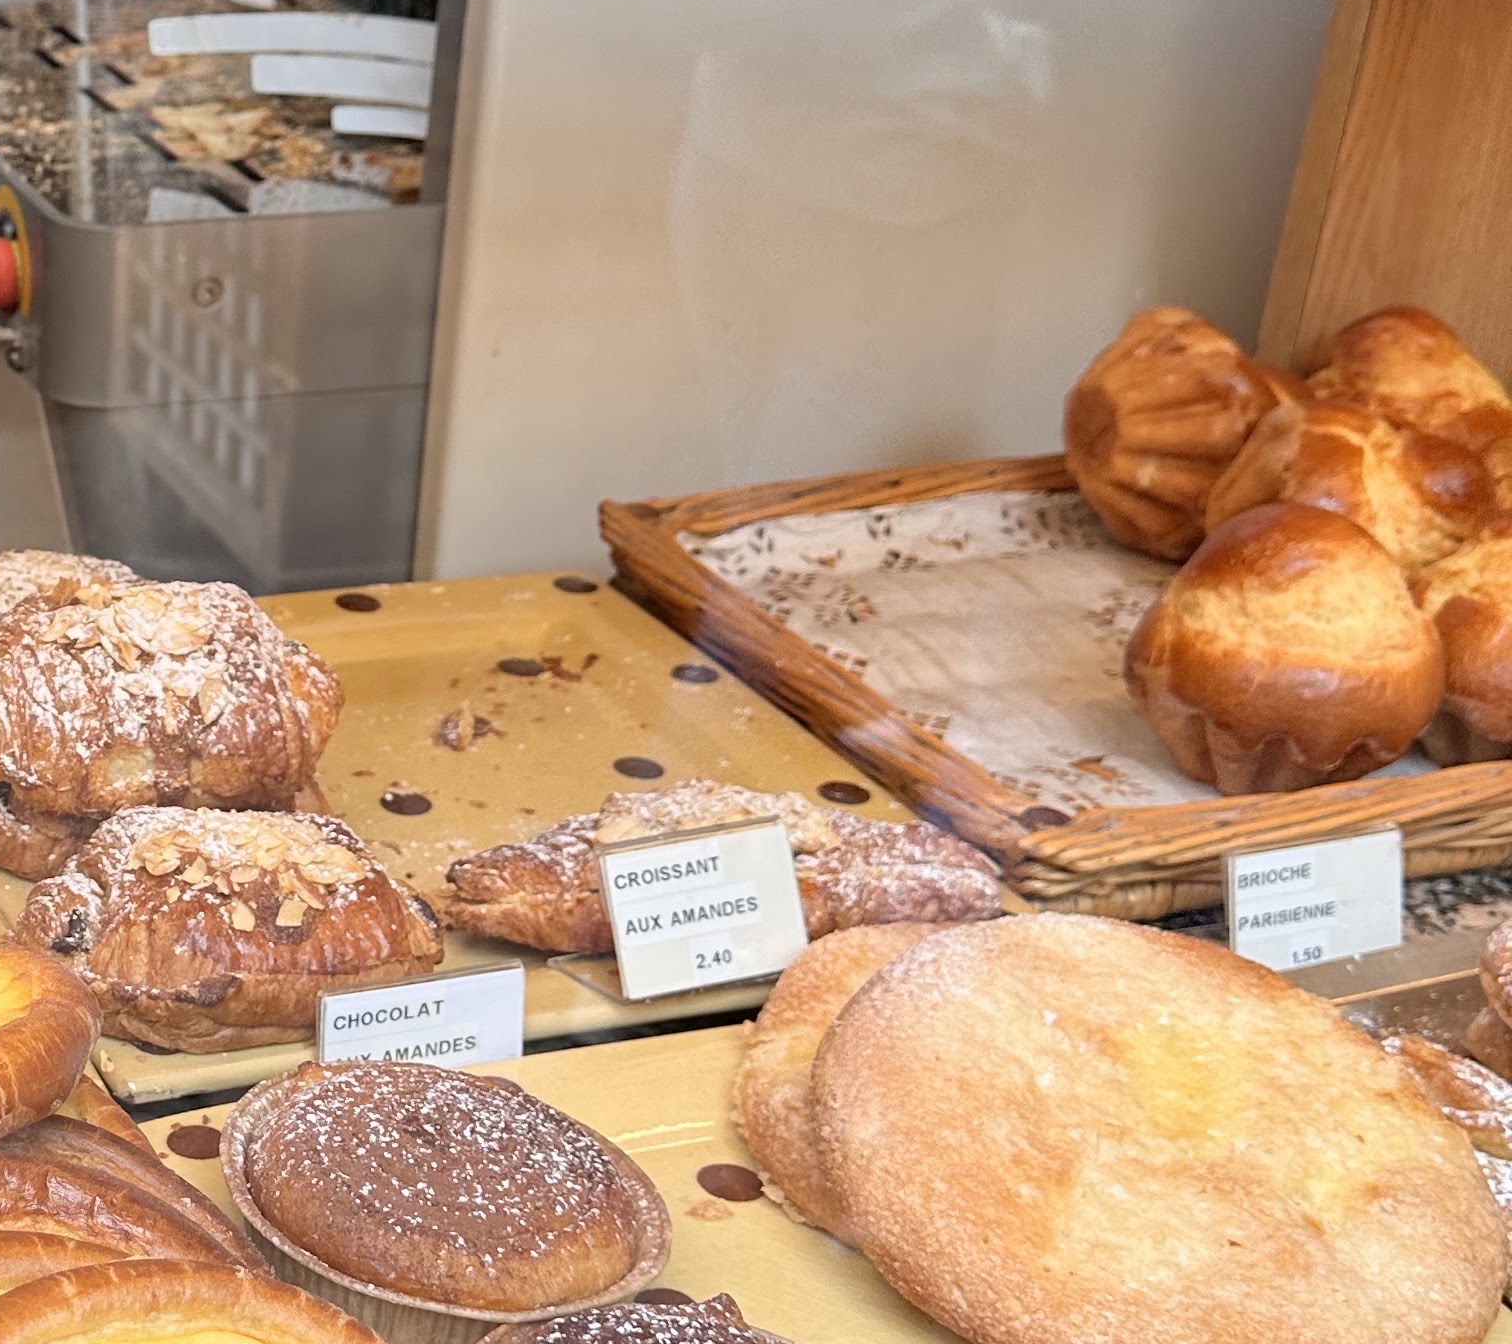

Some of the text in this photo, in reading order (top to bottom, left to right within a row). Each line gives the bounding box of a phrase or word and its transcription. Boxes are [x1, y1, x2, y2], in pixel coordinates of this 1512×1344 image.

[614, 855, 720, 891] CROISSANT
[1237, 862, 1312, 889] BRIOCHE
[625, 895, 759, 936] AUX AMANDES
[1238, 900, 1336, 931] PARISIENNE
[333, 1000, 444, 1030] CHOCOLAT
[382, 1035, 477, 1062] AMANDES
